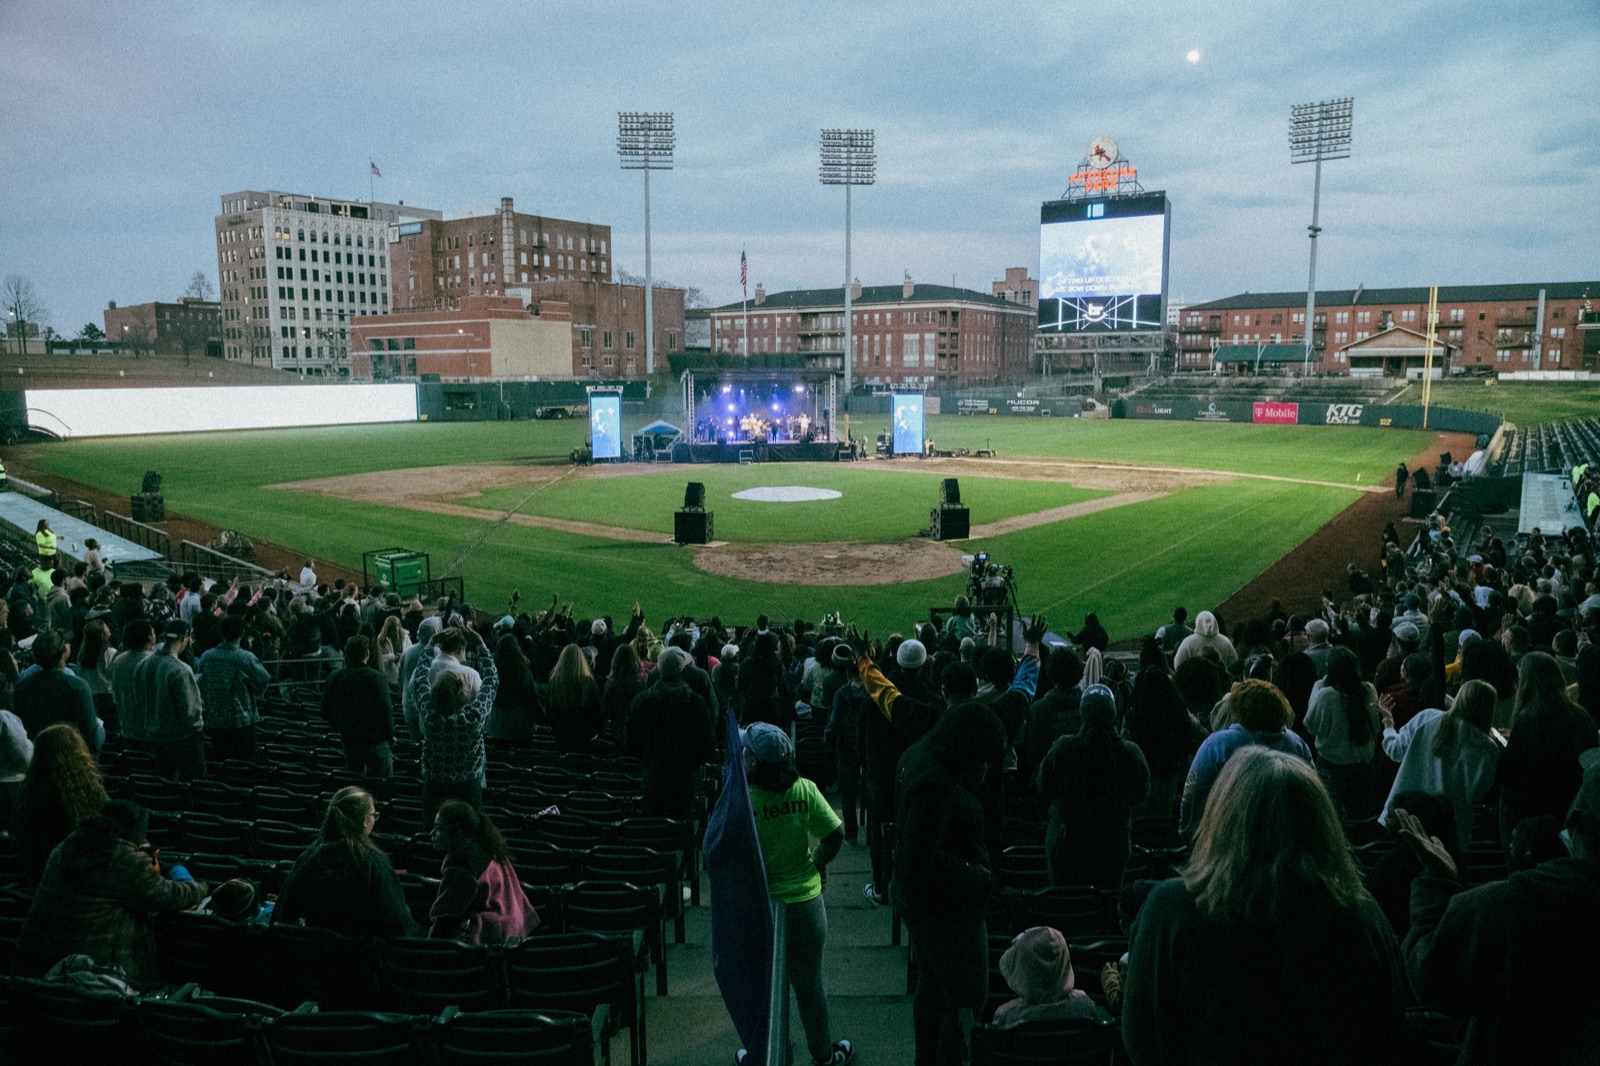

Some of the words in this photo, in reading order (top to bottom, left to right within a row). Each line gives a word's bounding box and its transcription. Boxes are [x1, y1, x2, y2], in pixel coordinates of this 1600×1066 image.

[1069, 166, 1137, 184] AUTOZONE
[1085, 178, 1118, 191] PARK
[1068, 285, 1085, 293] BOW
[1085, 284, 1108, 292] DOWN
[1265, 407, 1297, 419] Mobile
[1326, 403, 1364, 418] KTG
[763, 799, 809, 821] team
